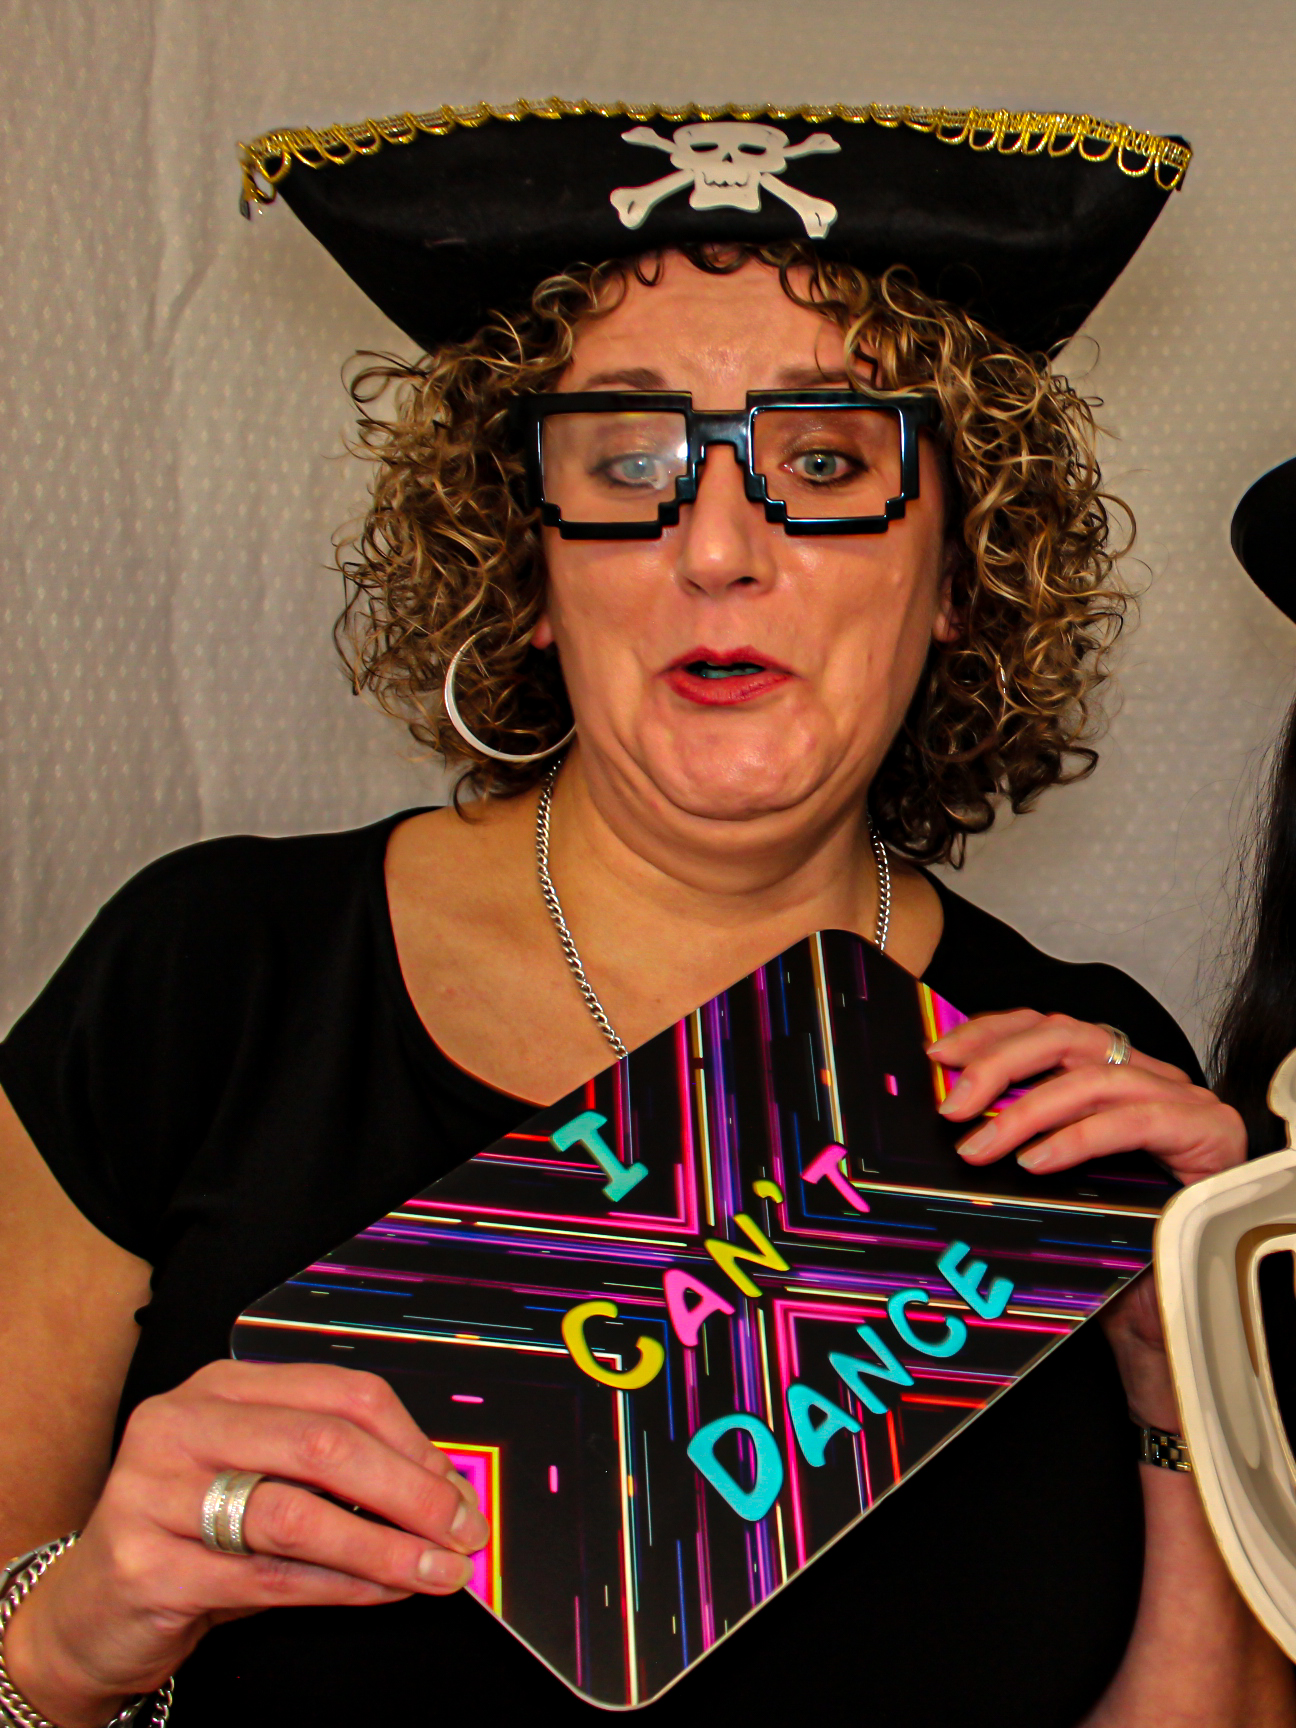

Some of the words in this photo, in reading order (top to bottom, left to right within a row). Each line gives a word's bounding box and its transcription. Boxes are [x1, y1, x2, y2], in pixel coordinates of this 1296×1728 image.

[551, 1111, 648, 1201] I
[562, 1143, 870, 1389] CAN'T
[688, 1242, 1014, 1521] DANCE
